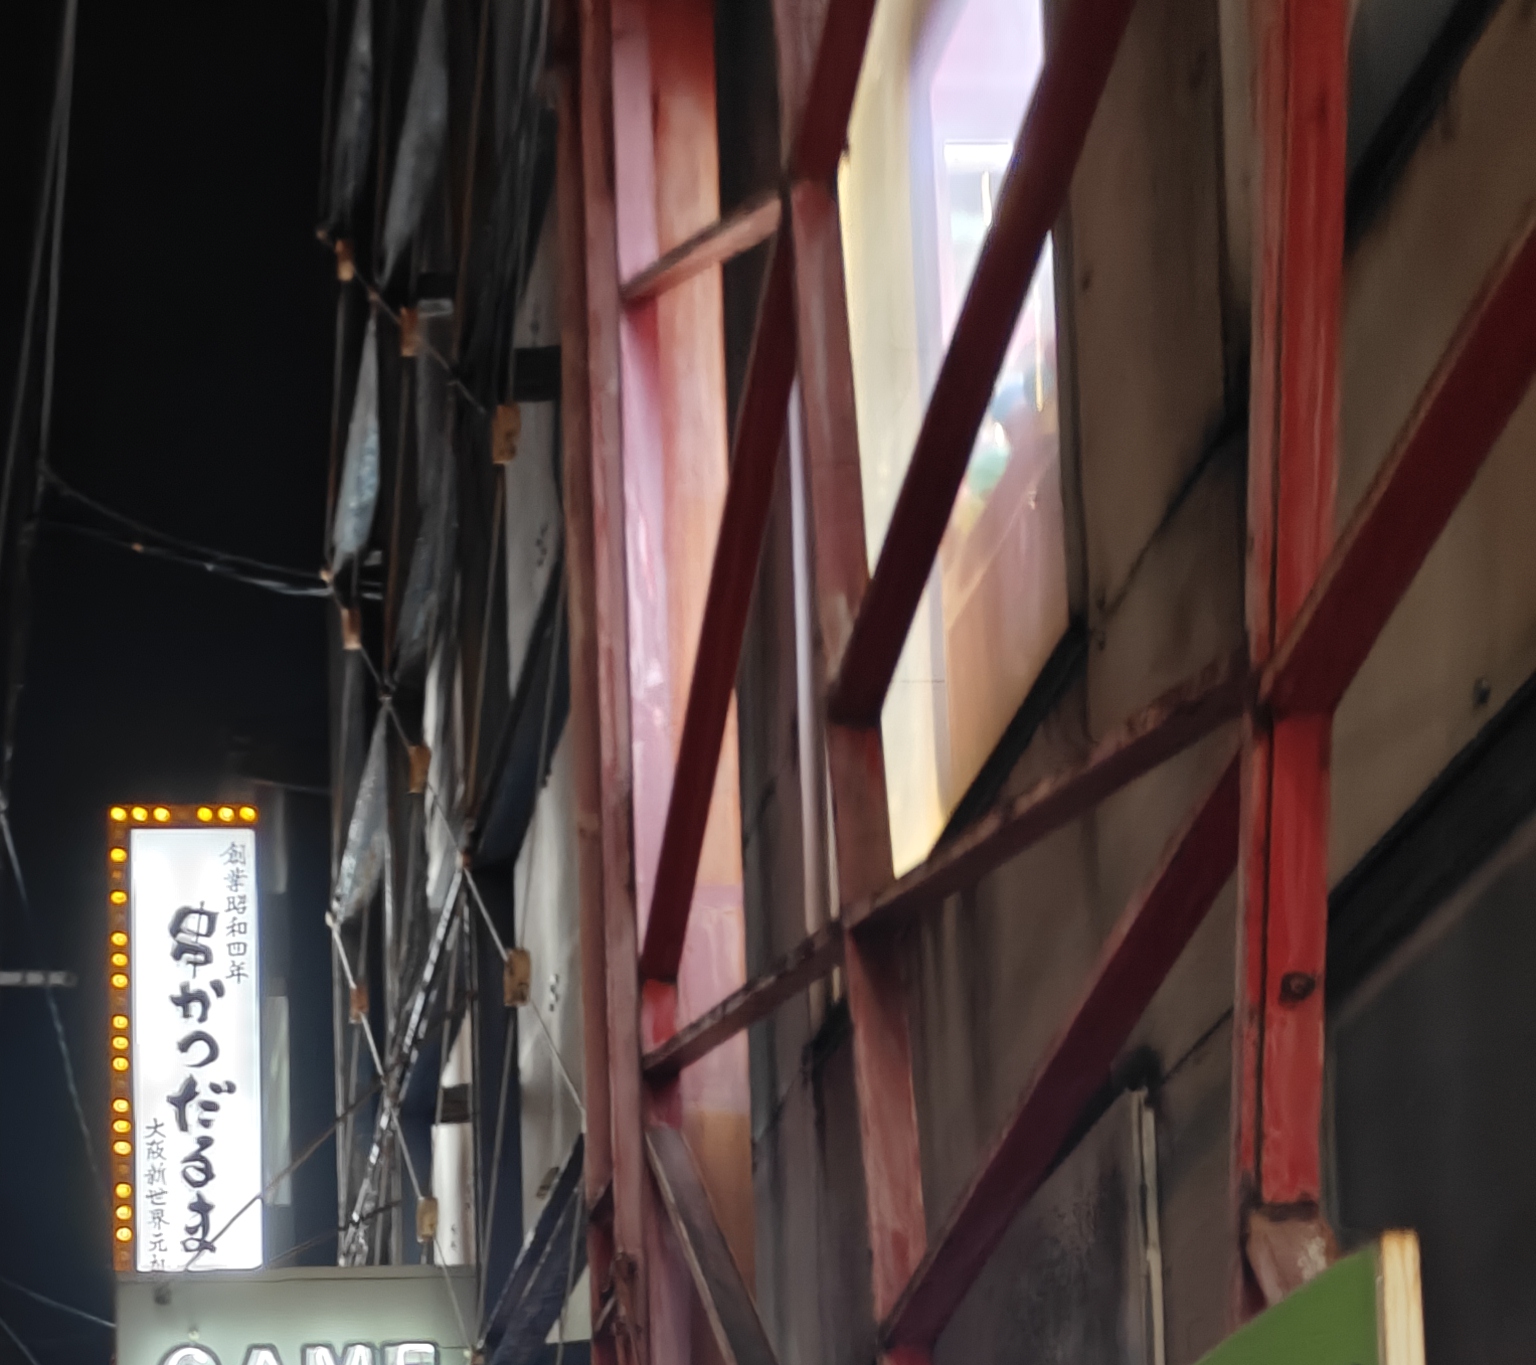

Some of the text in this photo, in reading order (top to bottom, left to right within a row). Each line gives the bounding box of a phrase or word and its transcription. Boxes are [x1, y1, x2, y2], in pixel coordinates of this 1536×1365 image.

[220, 841, 250, 984] 創業昭和四年
[166, 901, 237, 1254] 串かつだるま
